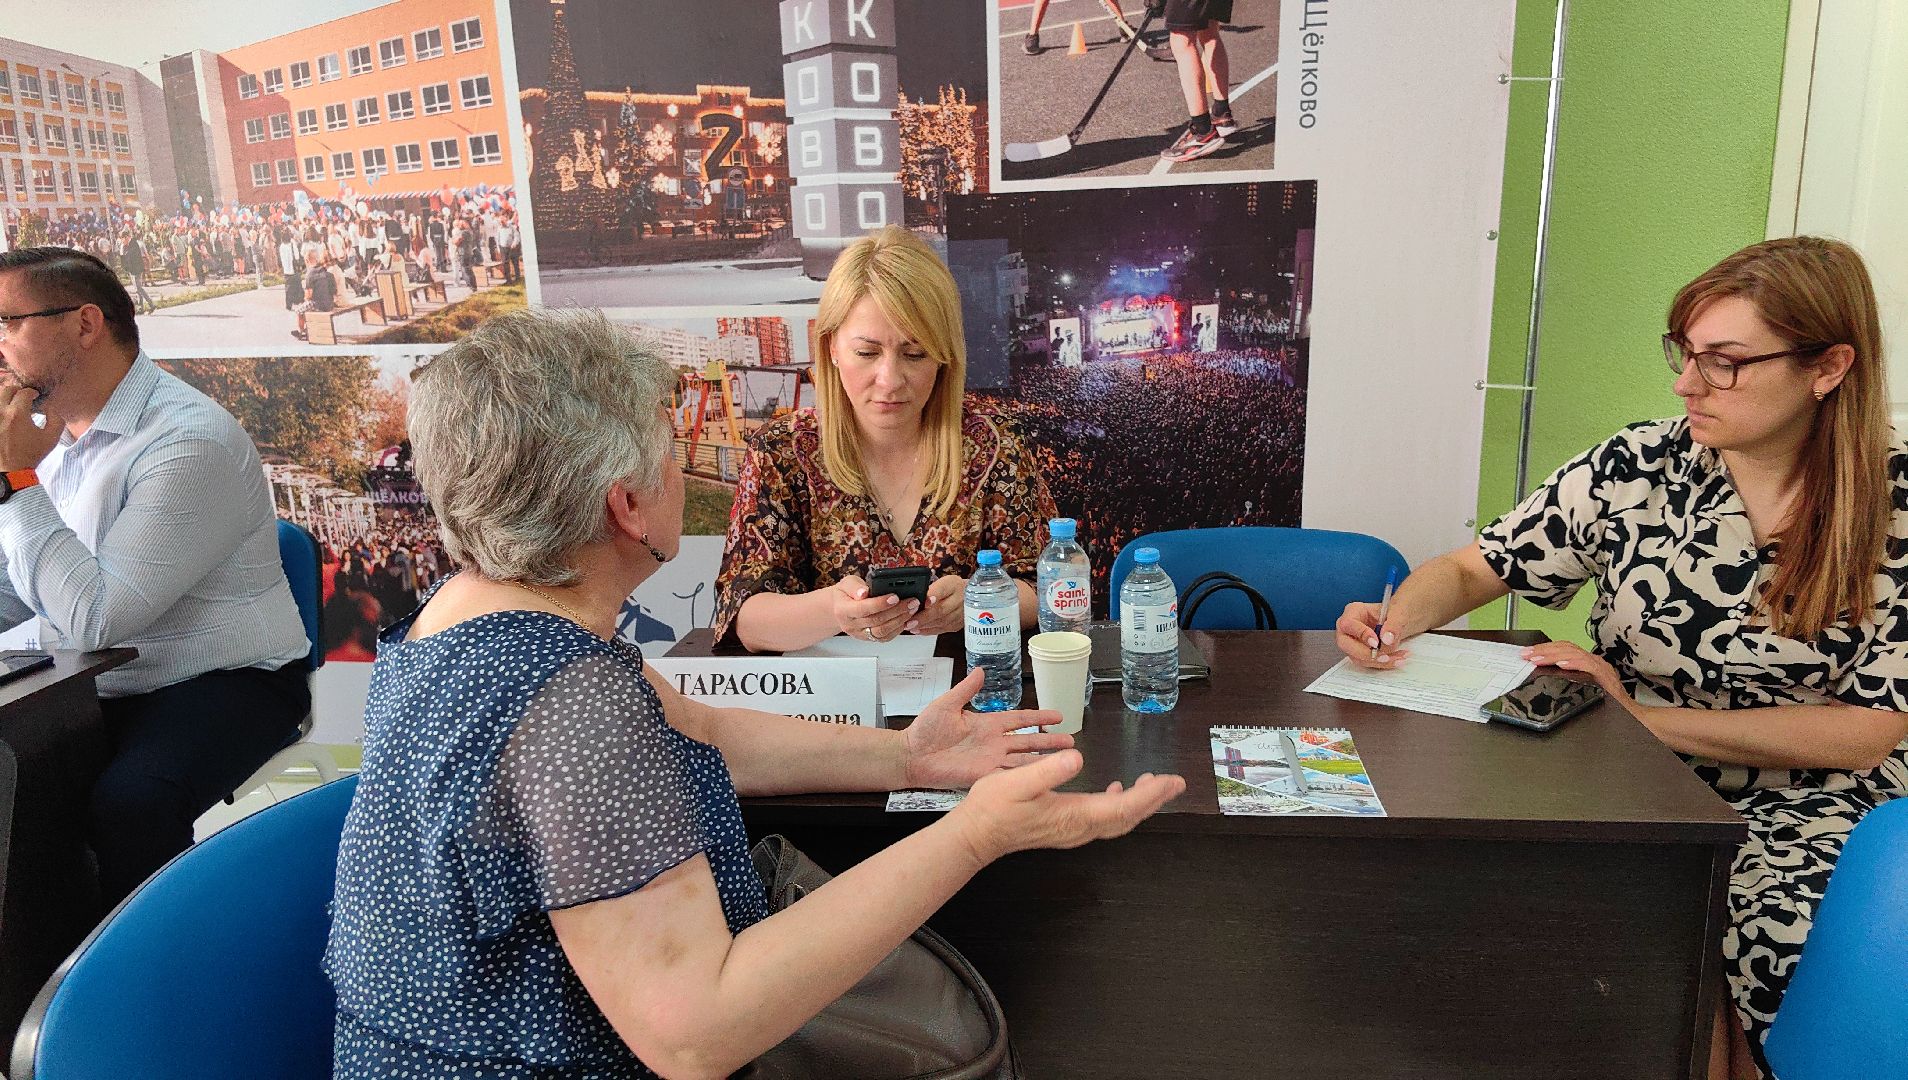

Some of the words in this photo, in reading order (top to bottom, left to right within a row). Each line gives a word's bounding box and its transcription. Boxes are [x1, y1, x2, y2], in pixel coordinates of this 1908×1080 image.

[1299, 0, 1329, 129] Щёлково
[1057, 587, 1086, 599] saint
[1054, 597, 1088, 611] spring
[674, 672, 815, 696] ТАРАСОВА
